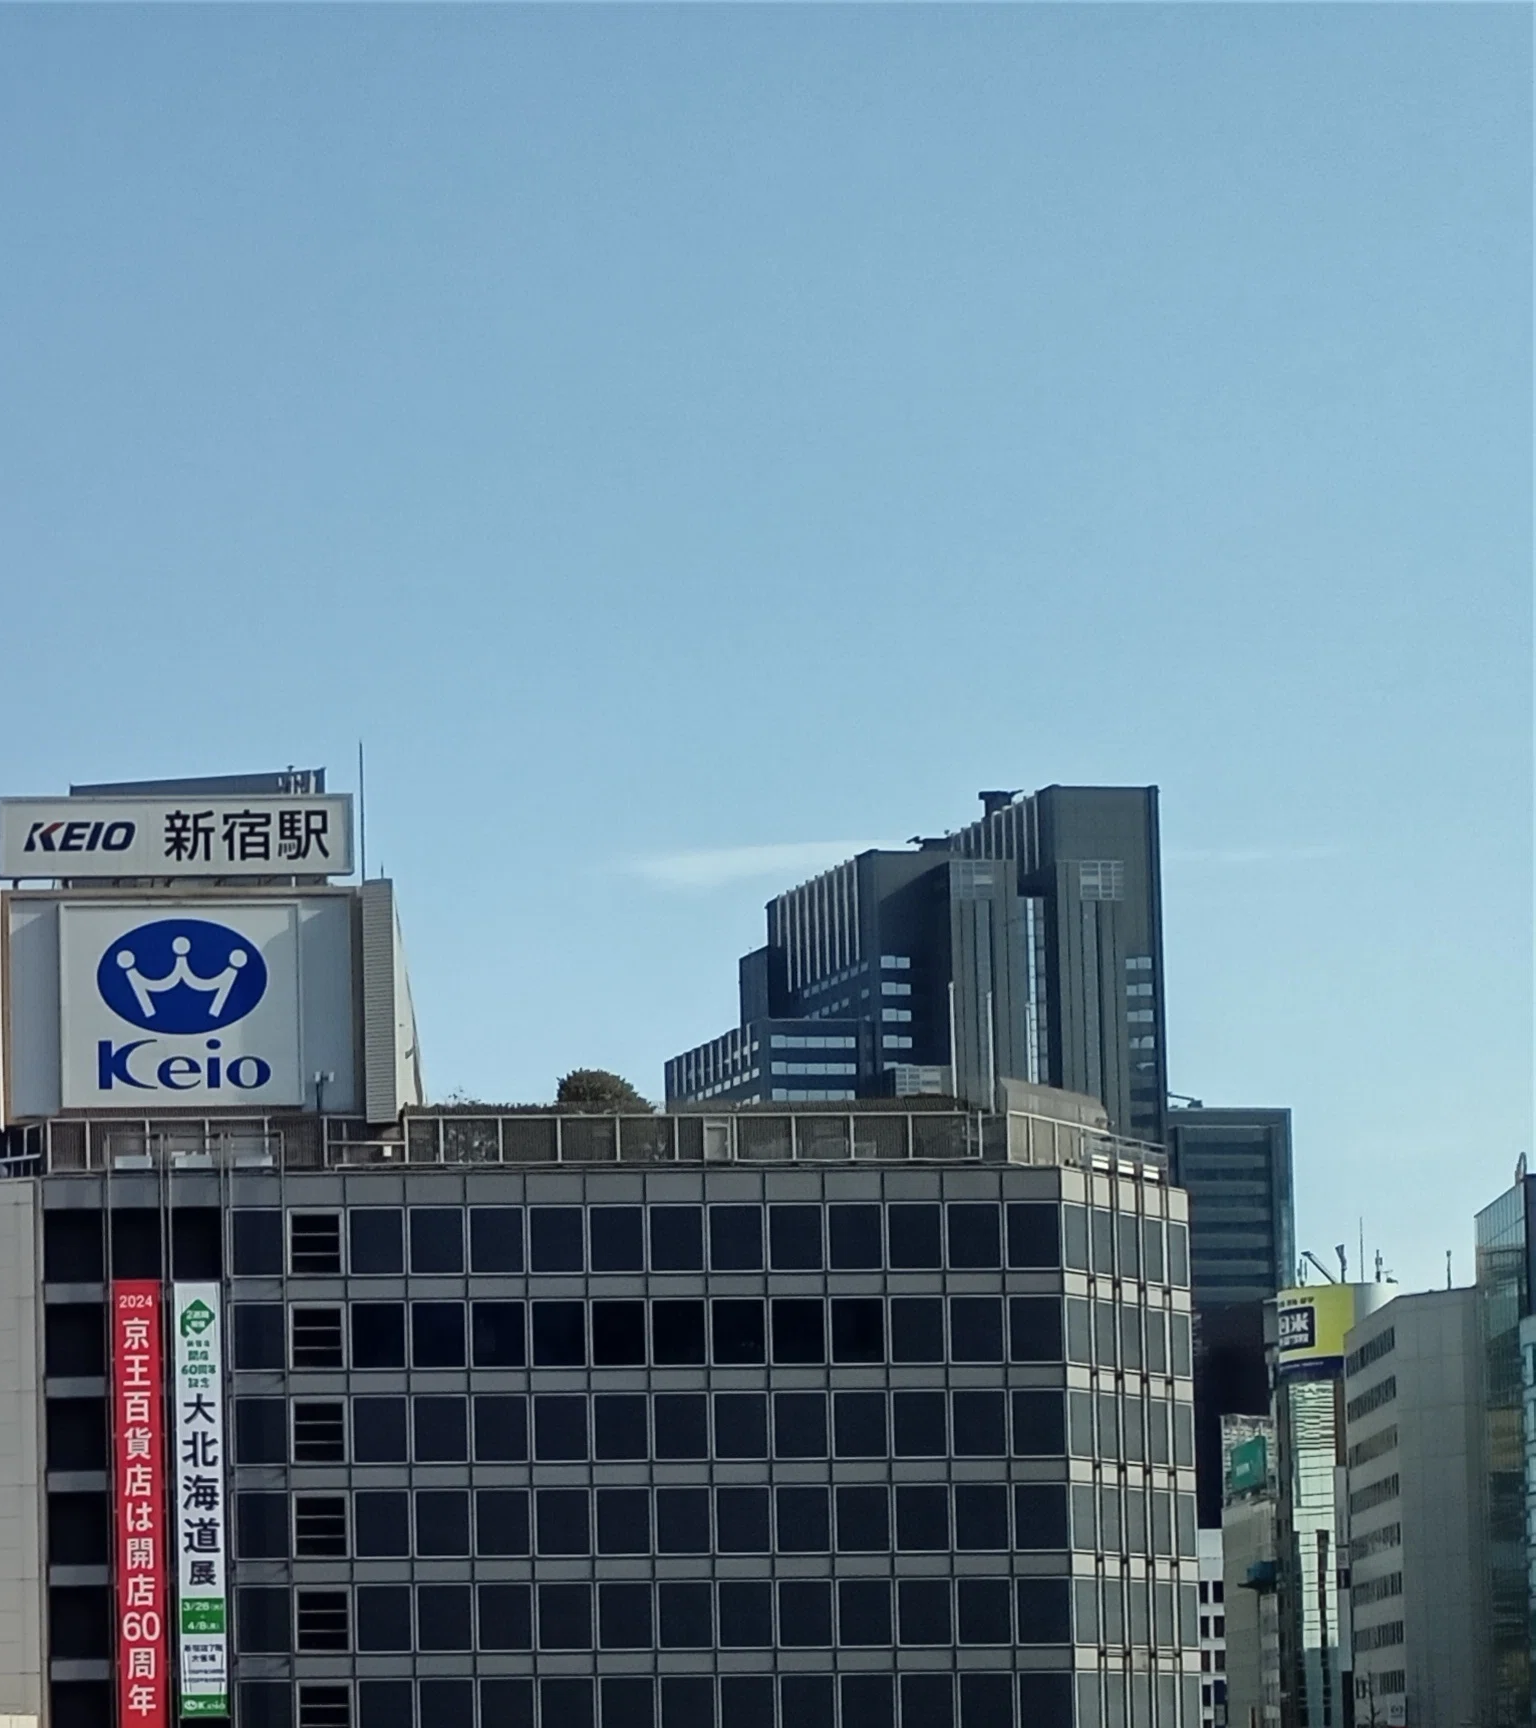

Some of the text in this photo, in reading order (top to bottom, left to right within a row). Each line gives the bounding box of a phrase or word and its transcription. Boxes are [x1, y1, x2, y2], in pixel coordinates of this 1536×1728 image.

[24, 808, 331, 862] KEIO 新宿駅
[97, 1038, 272, 1091] Keio
[119, 1294, 153, 1309] 2024
[122, 1316, 160, 1717] 京王百貨店は開店60周年
[181, 1393, 221, 1586] 大北海道展
